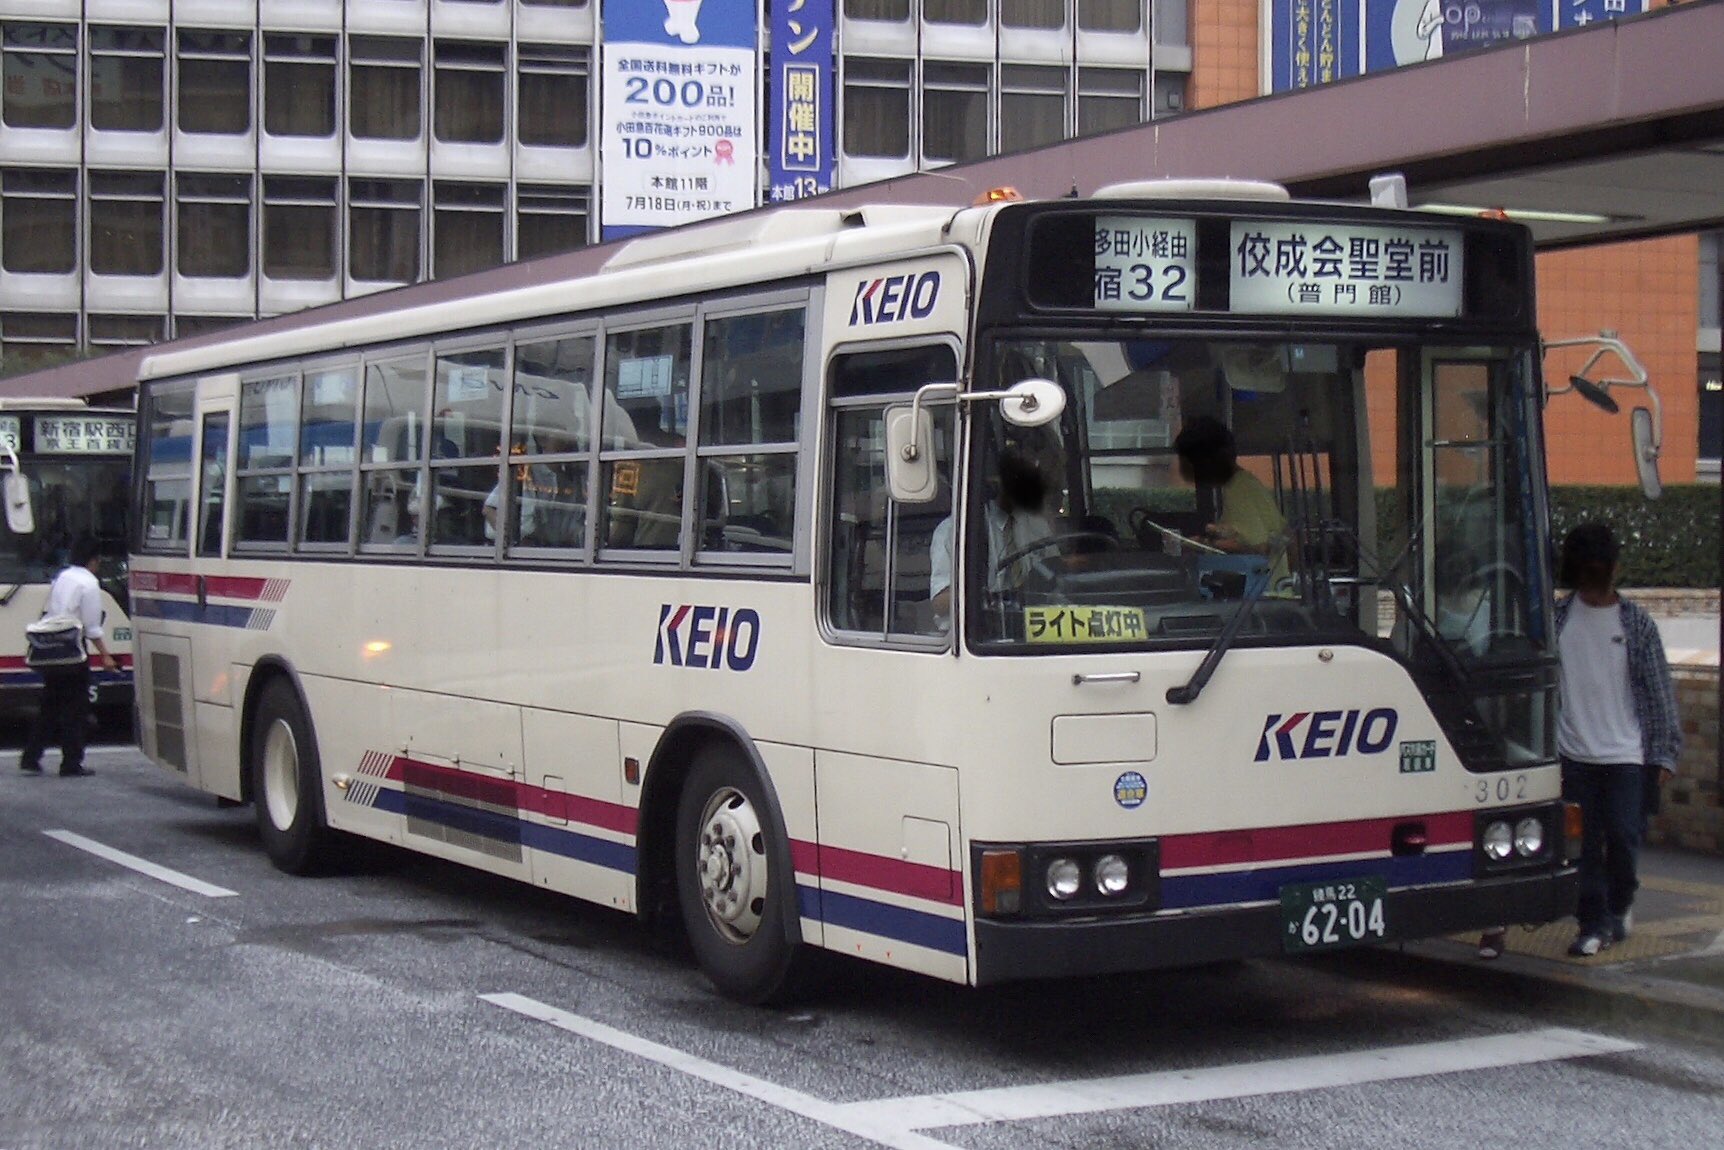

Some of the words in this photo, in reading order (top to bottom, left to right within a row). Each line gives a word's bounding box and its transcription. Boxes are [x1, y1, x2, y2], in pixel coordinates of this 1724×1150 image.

[618, 59, 741, 76] 全国送料無料ギフトが
[788, 72, 815, 162] 開催中
[651, 176, 708, 190] 本館11階
[1095, 228, 1187, 259] 多田小経由
[1238, 232, 1449, 283] 佼成会聖堂前
[849, 270, 941, 327] KEIO
[1095, 263, 1187, 301] 宿32
[1287, 283, 1402, 306] (普門館)
[654, 604, 761, 672] KEIO
[1029, 610, 1142, 638] ライト点灯中
[1253, 708, 1398, 762] KEIO
[1475, 775, 1527, 803] 302
